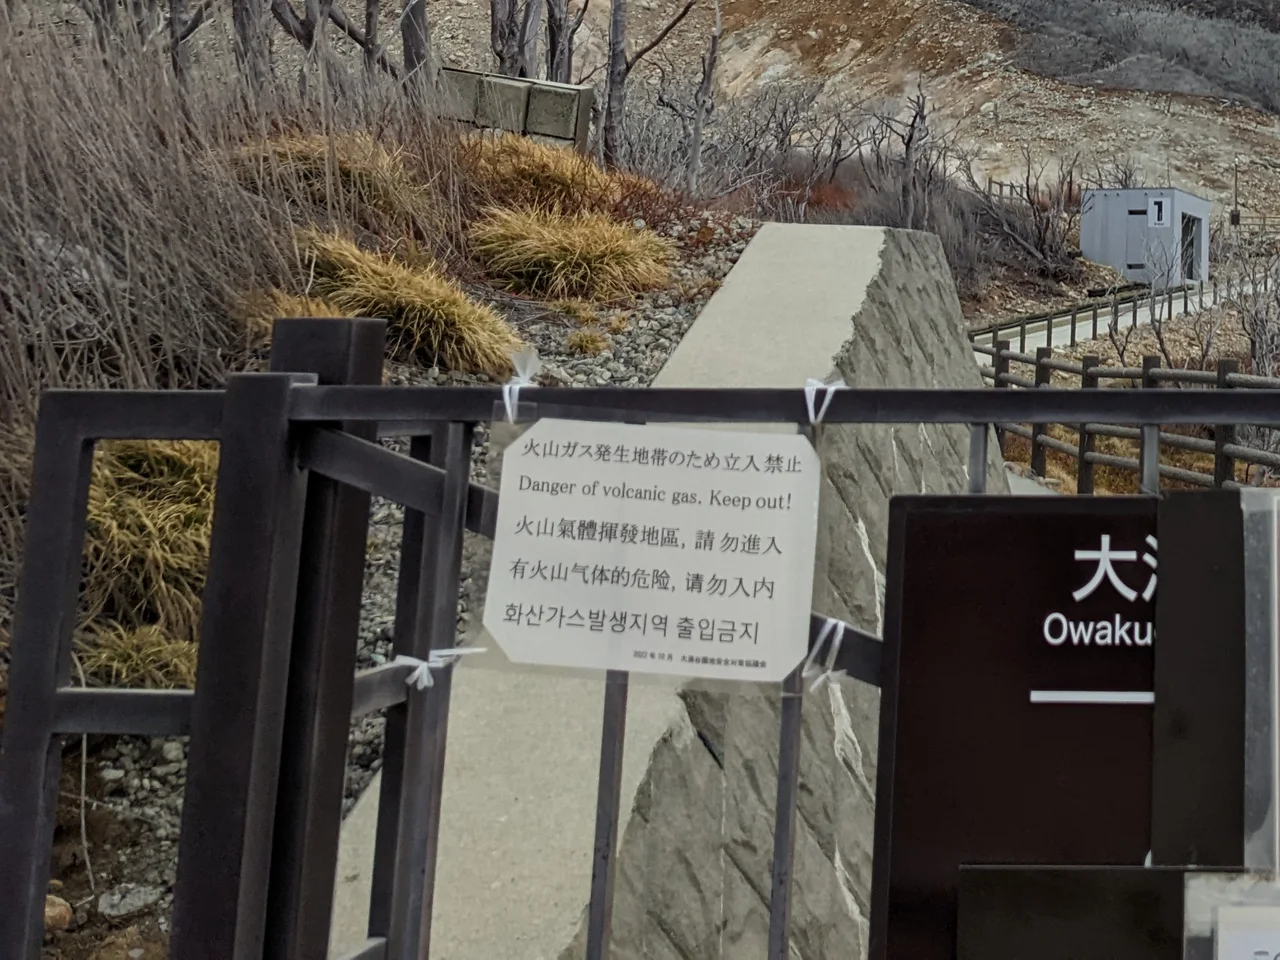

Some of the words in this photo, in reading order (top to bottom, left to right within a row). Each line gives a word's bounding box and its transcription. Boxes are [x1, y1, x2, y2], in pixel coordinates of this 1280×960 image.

[1153, 200, 1163, 222] 1
[520, 437, 803, 475] 火山ガス発生地帯のため立入禁止
[519, 475, 577, 499] Danger
[581, 481, 599, 497] of
[602, 482, 667, 503] volcanic
[671, 490, 703, 507] gas.
[709, 489, 752, 511] Keep
[755, 492, 793, 511] out!
[1072, 533, 1158, 602] 大
[502, 602, 669, 637] 화산가스발생지역
[675, 616, 760, 645] 출입금지
[1043, 611, 1155, 647] Owaku
